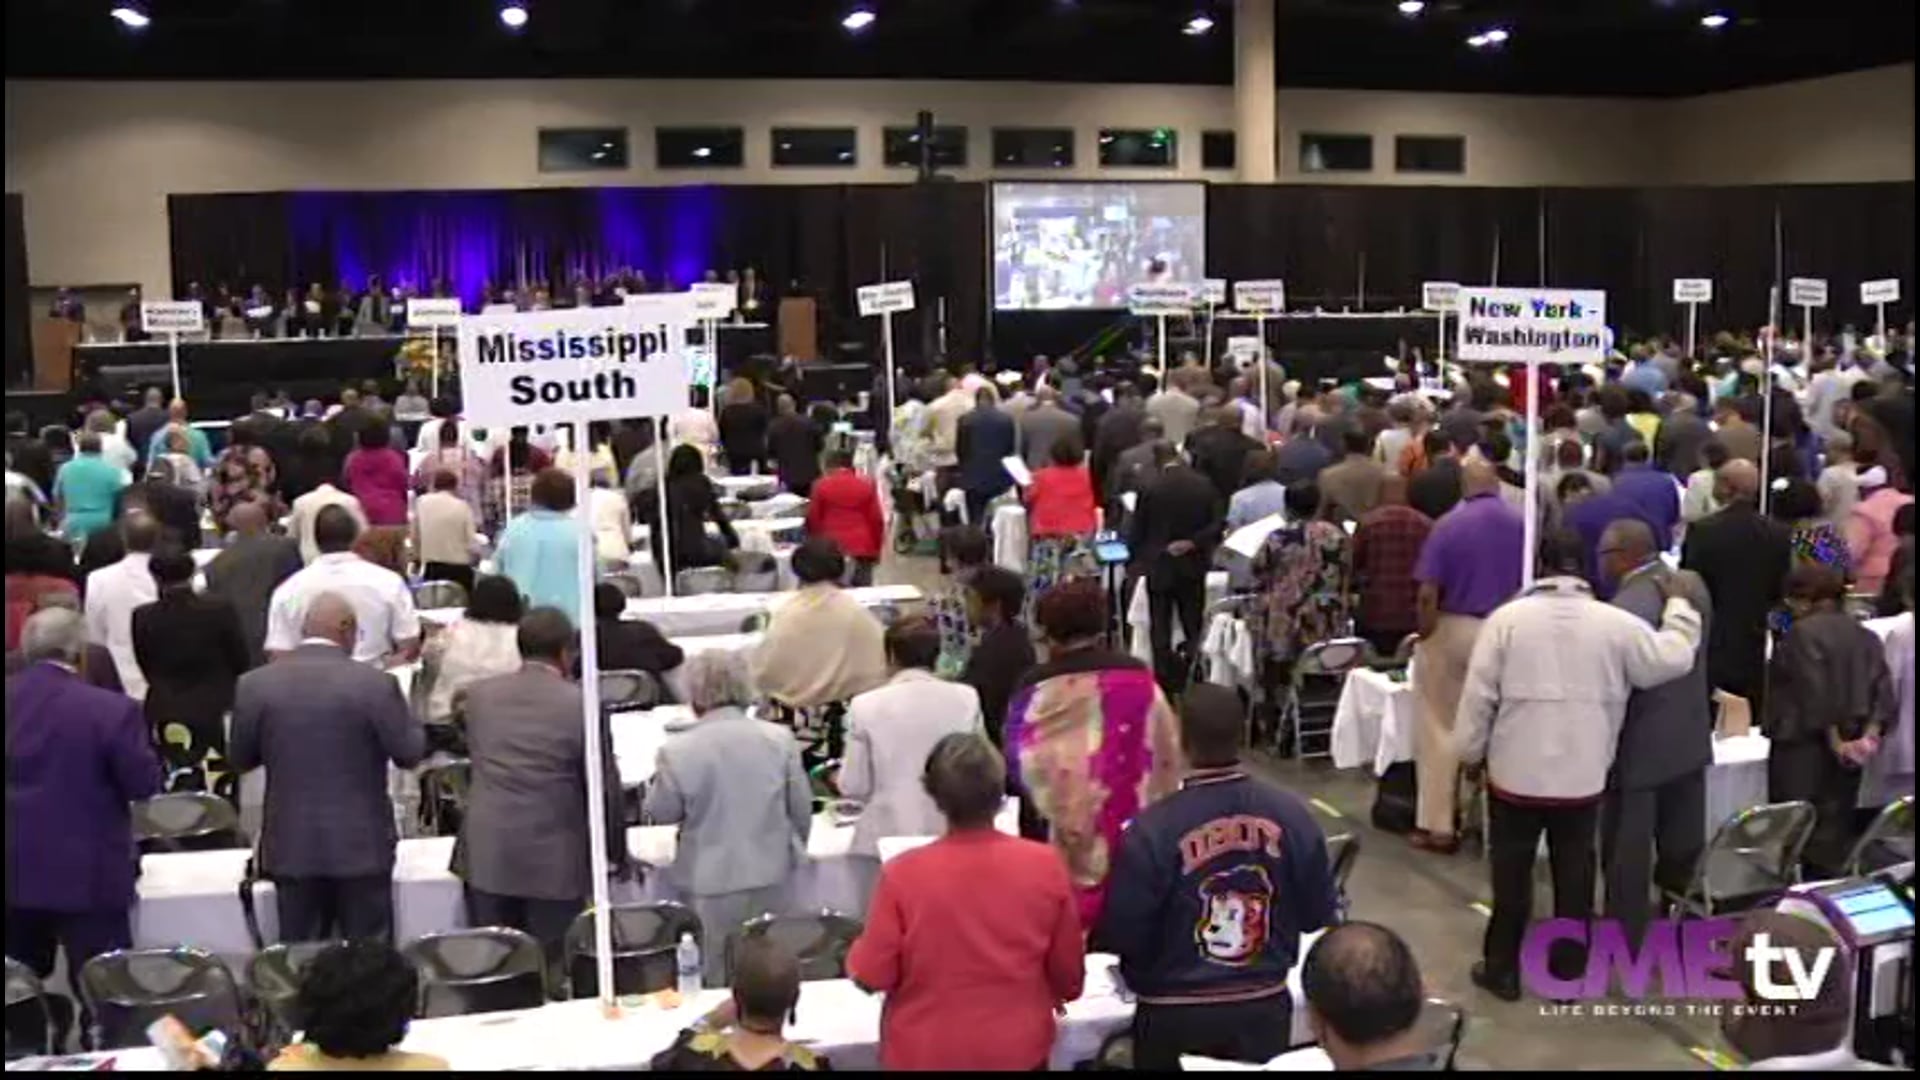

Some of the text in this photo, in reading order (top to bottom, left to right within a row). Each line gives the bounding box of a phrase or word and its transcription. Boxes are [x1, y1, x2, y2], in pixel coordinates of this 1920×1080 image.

[1470, 297, 1522, 318] New
[1531, 297, 1583, 318] York
[477, 323, 669, 364] Mississippi
[1465, 326, 1600, 352] Washington
[511, 370, 636, 405] South
